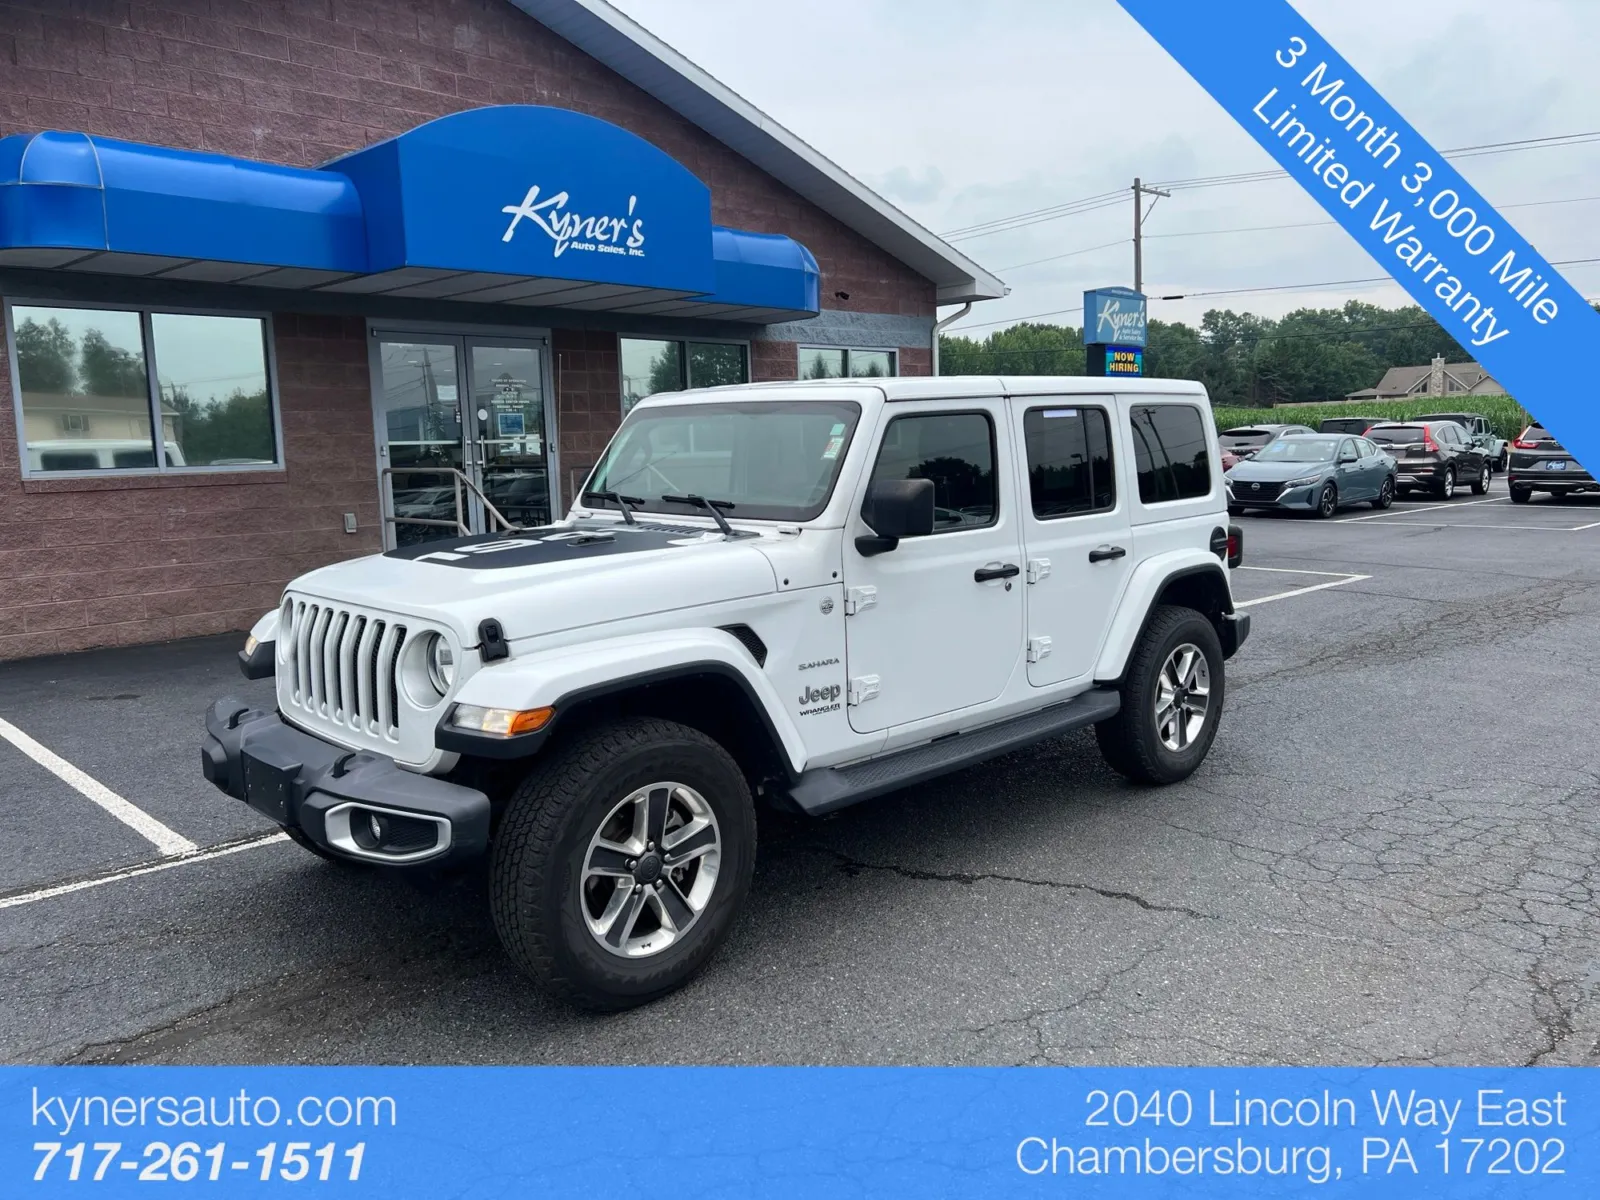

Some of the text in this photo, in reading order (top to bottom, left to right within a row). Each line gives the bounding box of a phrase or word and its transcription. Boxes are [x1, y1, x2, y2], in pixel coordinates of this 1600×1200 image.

[501, 185, 645, 258] Kyner's
[571, 241, 646, 257] Auto Sales, Inc.
[1097, 299, 1145, 342] Kyner's
[1114, 351, 1135, 361] NOW
[1109, 362, 1139, 373] HIRING
[798, 658, 840, 671] SAHARA
[798, 684, 841, 705] Jeep
[799, 703, 841, 716] WRANGLER
